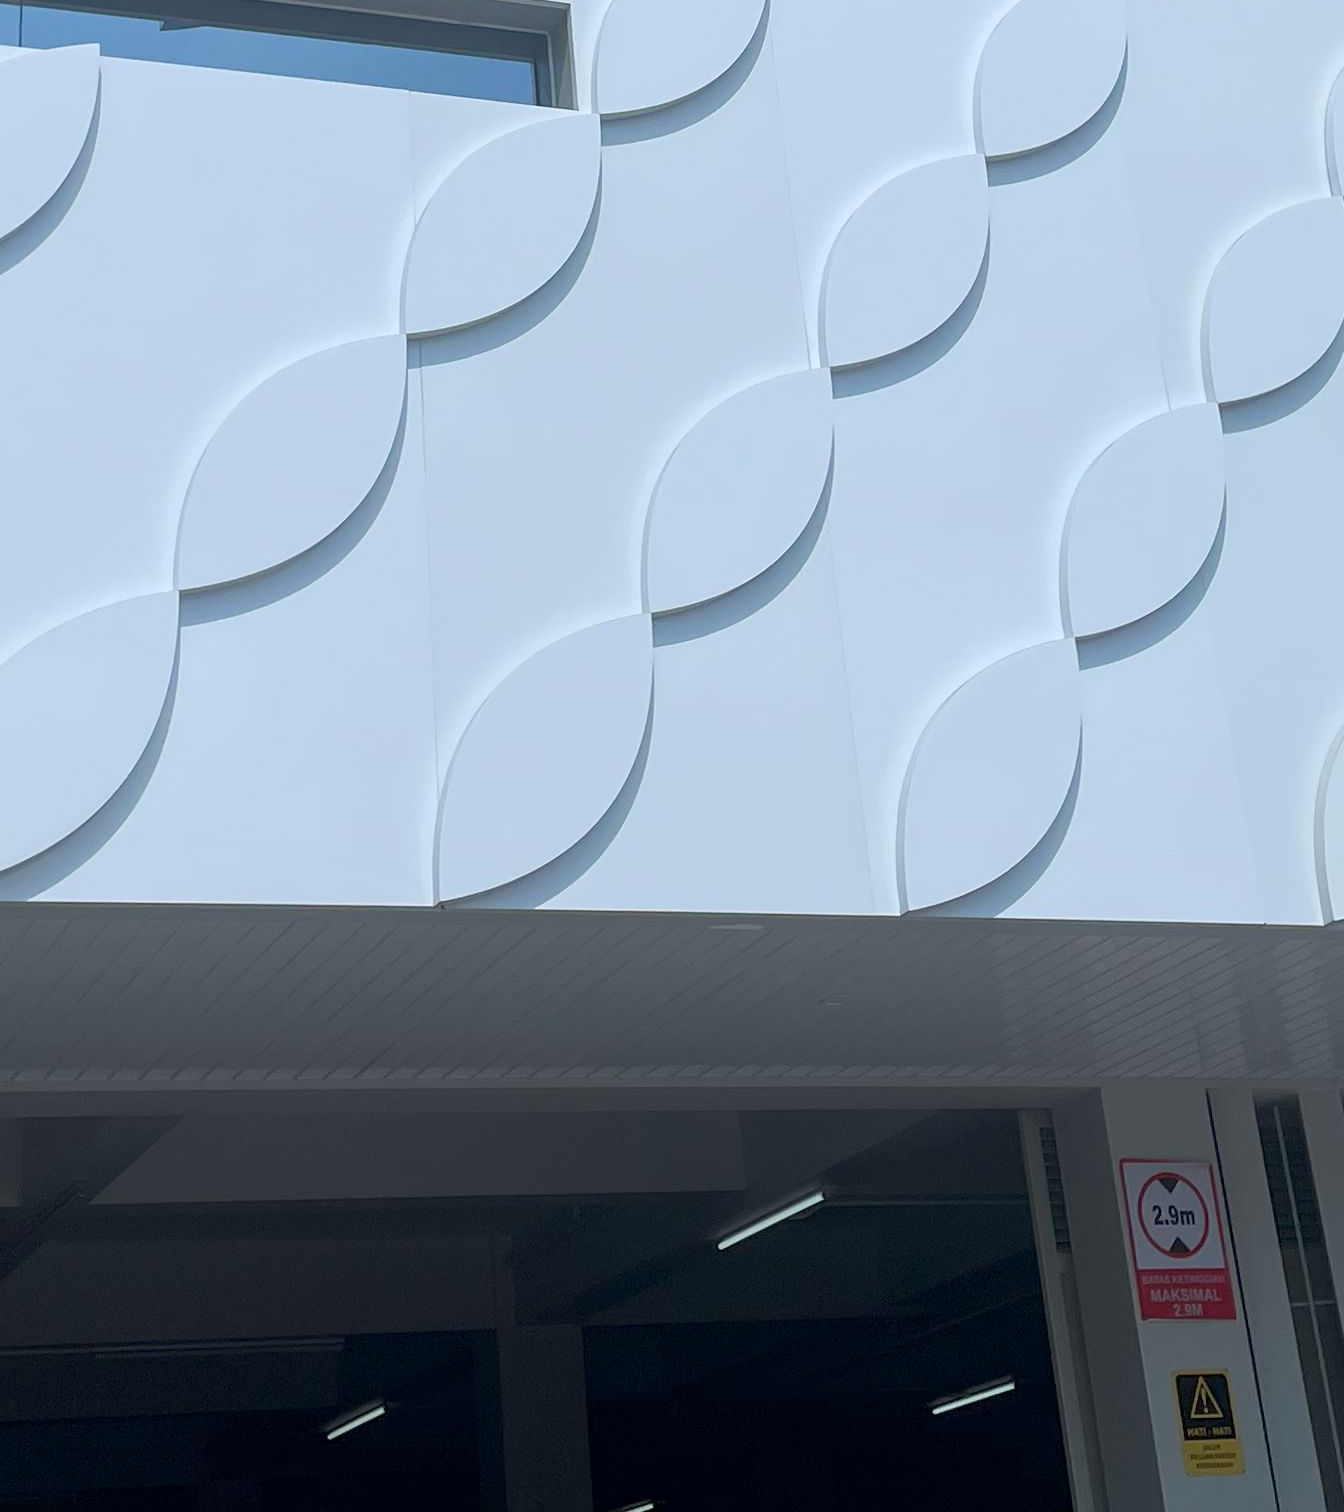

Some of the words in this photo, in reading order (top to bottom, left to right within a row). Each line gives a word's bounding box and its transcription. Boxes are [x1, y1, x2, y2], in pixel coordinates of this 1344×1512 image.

[1152, 1205, 1196, 1225] 2.9m
[1150, 1287, 1222, 1302] MAKSIMAL
[1173, 1303, 1204, 1317] 2.9M
